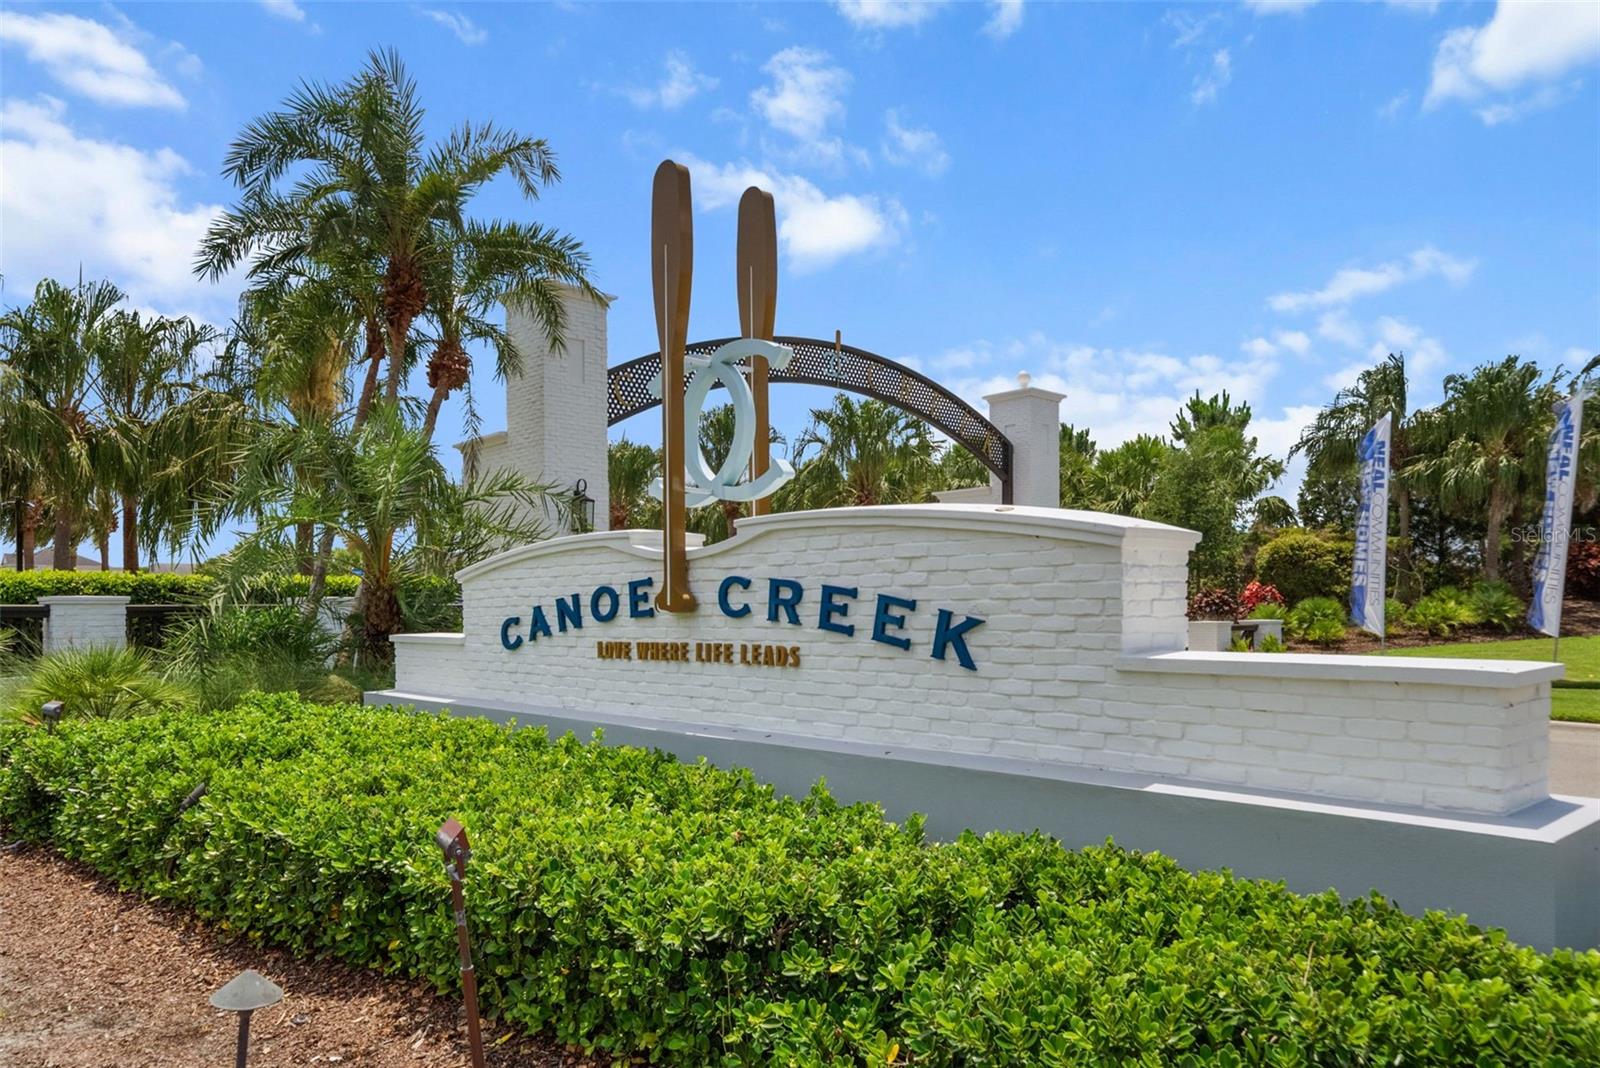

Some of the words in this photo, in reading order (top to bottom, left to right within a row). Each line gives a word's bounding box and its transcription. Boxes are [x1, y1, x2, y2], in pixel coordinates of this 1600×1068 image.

[1373, 440, 1386, 493] NEAL
[1560, 424, 1574, 480] NEAL
[1368, 493, 1385, 606] COMMUNITIES
[500, 577, 655, 651] CANOE
[718, 575, 986, 671] CREEK
[597, 641, 632, 661] LOVE
[636, 642, 690, 662] WHERE
[695, 643, 734, 664] LIFE
[740, 645, 801, 667] LEADS
